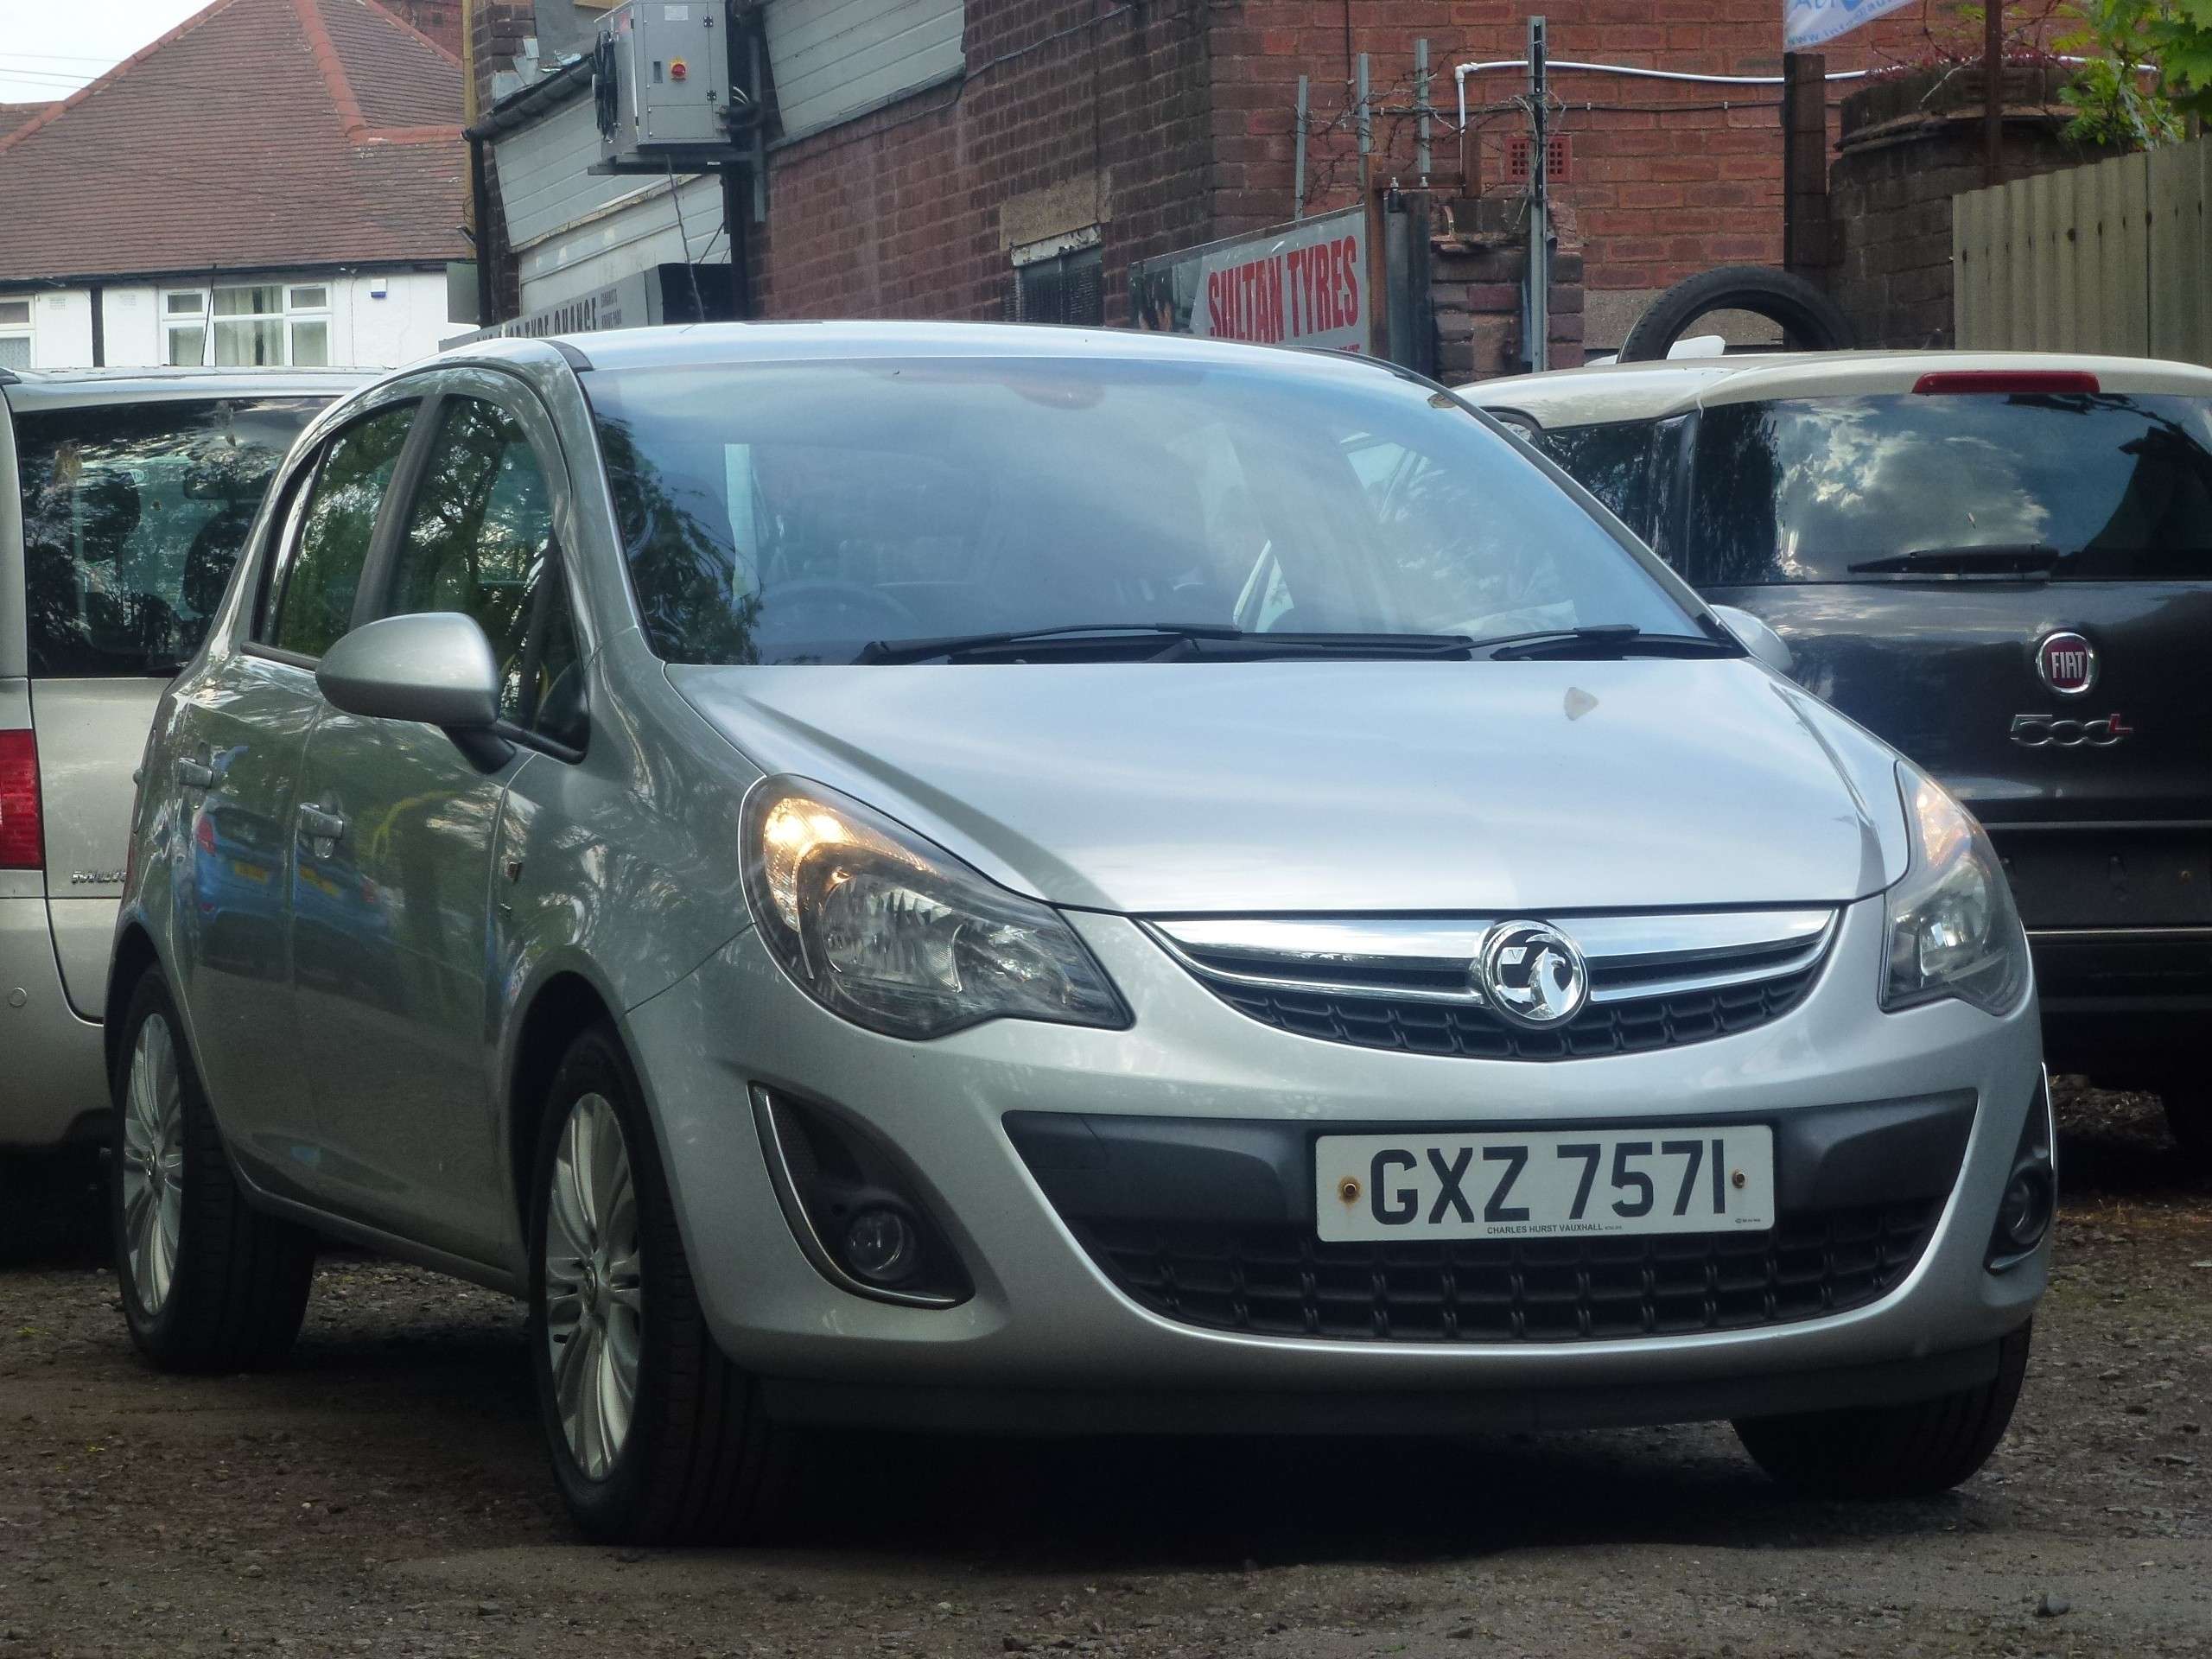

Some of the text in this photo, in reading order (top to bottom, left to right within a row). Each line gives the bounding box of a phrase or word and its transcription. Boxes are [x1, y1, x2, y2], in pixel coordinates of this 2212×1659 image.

[1207, 235, 1359, 345] SULTAN TYRES
[2051, 652, 2085, 679] FIAT
[1370, 1138, 1726, 1226] GXZ 7571
[1486, 1225, 1528, 1235] CHARLES
[1529, 1224, 1557, 1234] HURST
[1559, 1223, 1604, 1232] VAUXHALL
